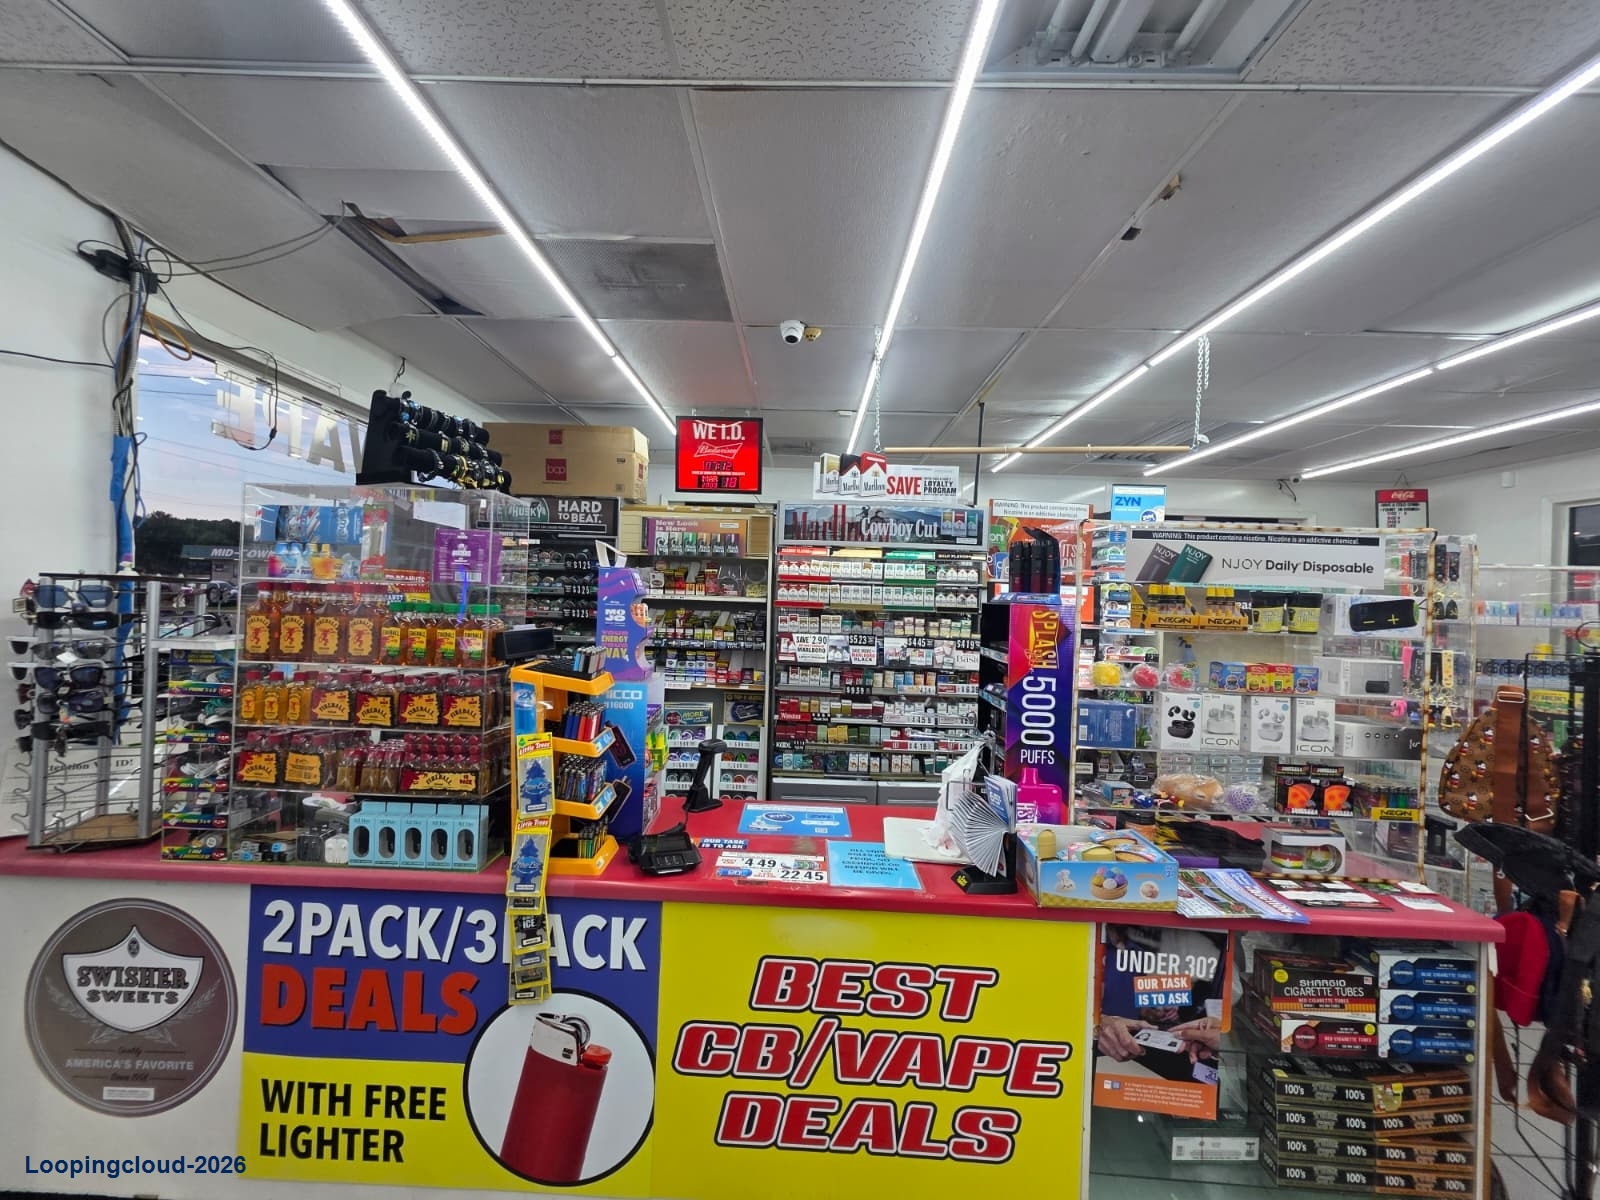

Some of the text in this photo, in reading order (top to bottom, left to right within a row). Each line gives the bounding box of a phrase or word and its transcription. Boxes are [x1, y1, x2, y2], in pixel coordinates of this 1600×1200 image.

[692, 422, 745, 440] WE I.D.
[886, 475, 922, 496] SAVE
[558, 500, 602, 513] HARD
[1114, 496, 1142, 506] ZYN
[571, 513, 602, 523] BEAT.
[861, 516, 938, 541] Cowboy Cut
[1155, 545, 1177, 560] NJOY
[1185, 546, 1207, 561] NJOY
[1222, 558, 1374, 575] NJOY Daily Disposable
[1158, 616, 1192, 624] NEON
[1207, 618, 1242, 626] NEON
[602, 635, 628, 643] ENERGY
[1031, 609, 1060, 670] SPLASH
[319, 702, 345, 714] FIREBALL
[361, 706, 387, 719] FIREBALL
[407, 704, 434, 717] FIREBALL
[450, 706, 477, 719] FIREBALL
[1020, 675, 1056, 746] 5000
[1201, 738, 1240, 746] ICON
[519, 744, 536, 756] Little
[1296, 745, 1335, 753] ICON
[1020, 749, 1056, 765] PUFFS
[245, 764, 273, 776] FIREBALL
[425, 775, 454, 786] FIREBALL
[522, 918, 536, 929] ICE
[1116, 948, 1219, 980] UNDER 30?
[77, 965, 190, 990] SWISHER
[748, 955, 1000, 1022] BEST
[1137, 977, 1188, 991] OUR TASK
[86, 989, 180, 1004] SWEETS
[1284, 987, 1365, 997] CIGARETTE TUBES
[259, 963, 480, 1036] DEALS
[1138, 992, 1190, 1006] IS TO ASK
[672, 1014, 1072, 1098] CB/VAPE
[65, 1059, 194, 1070] AMERICA'S FAVORITE
[1284, 1083, 1305, 1095] 100's
[1345, 1089, 1366, 1101] 100's
[1442, 1085, 1464, 1095] 100's
[261, 1078, 447, 1121] WITH FREE
[1286, 1111, 1306, 1124] 100's
[1346, 1117, 1366, 1129] 100's
[1383, 1117, 1404, 1129] 100's
[1443, 1113, 1465, 1124] 100's
[714, 1091, 1022, 1164] DEALS
[259, 1122, 405, 1164] LIGHTER
[1287, 1140, 1307, 1152] 100's
[1347, 1145, 1367, 1157] 100's
[1385, 1148, 1406, 1160] 100's
[1446, 1152, 1467, 1164] 100's
[1286, 1167, 1306, 1179] 100's
[1346, 1172, 1366, 1184] 100's
[1385, 1175, 1405, 1187] 100's
[1445, 1178, 1466, 1191] 100's
